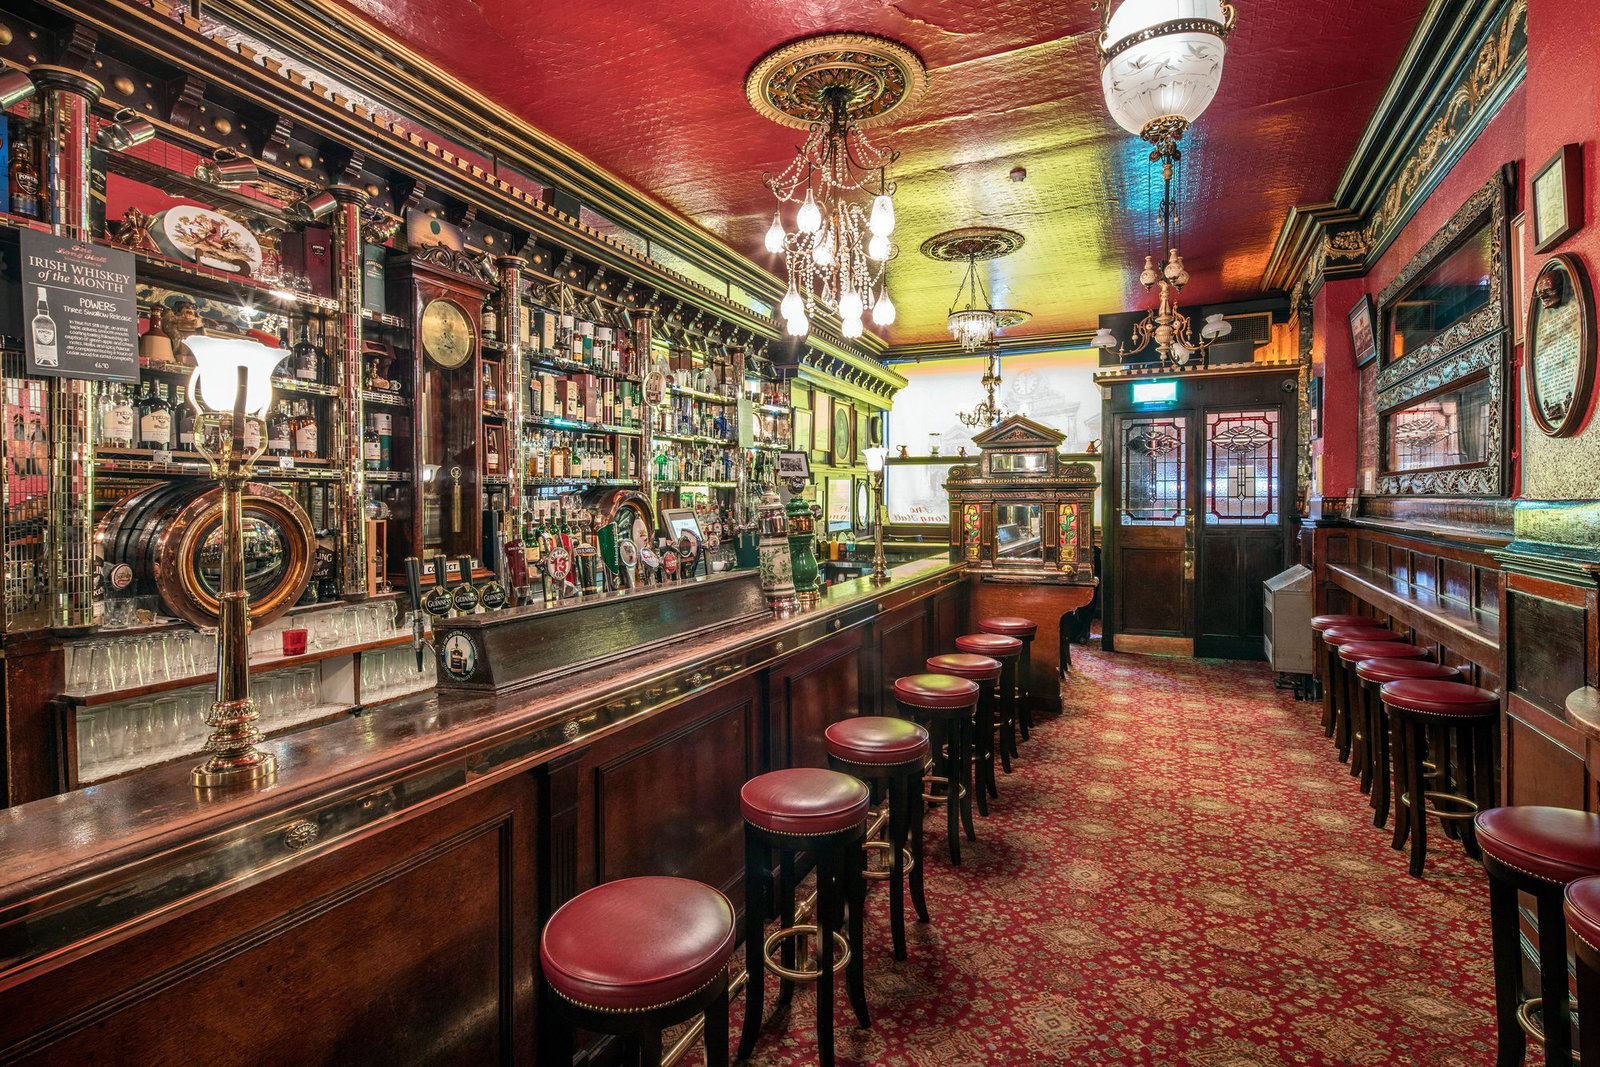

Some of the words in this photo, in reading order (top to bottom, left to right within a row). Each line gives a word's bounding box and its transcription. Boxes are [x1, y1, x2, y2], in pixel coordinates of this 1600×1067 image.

[29, 256, 67, 272] IRISH
[71, 264, 130, 284] WHISKEY
[38, 270, 51, 281] of
[53, 272, 70, 283] the
[73, 275, 124, 293] MONTH
[80, 298, 116, 312] POWERS
[84, 309, 109, 318] Swallow
[110, 313, 132, 322] Release
[428, 564, 457, 573] COECT
[551, 558, 566, 571] 13
[428, 599, 451, 608] GUINNESS
[483, 593, 504, 601] GUINNESS
